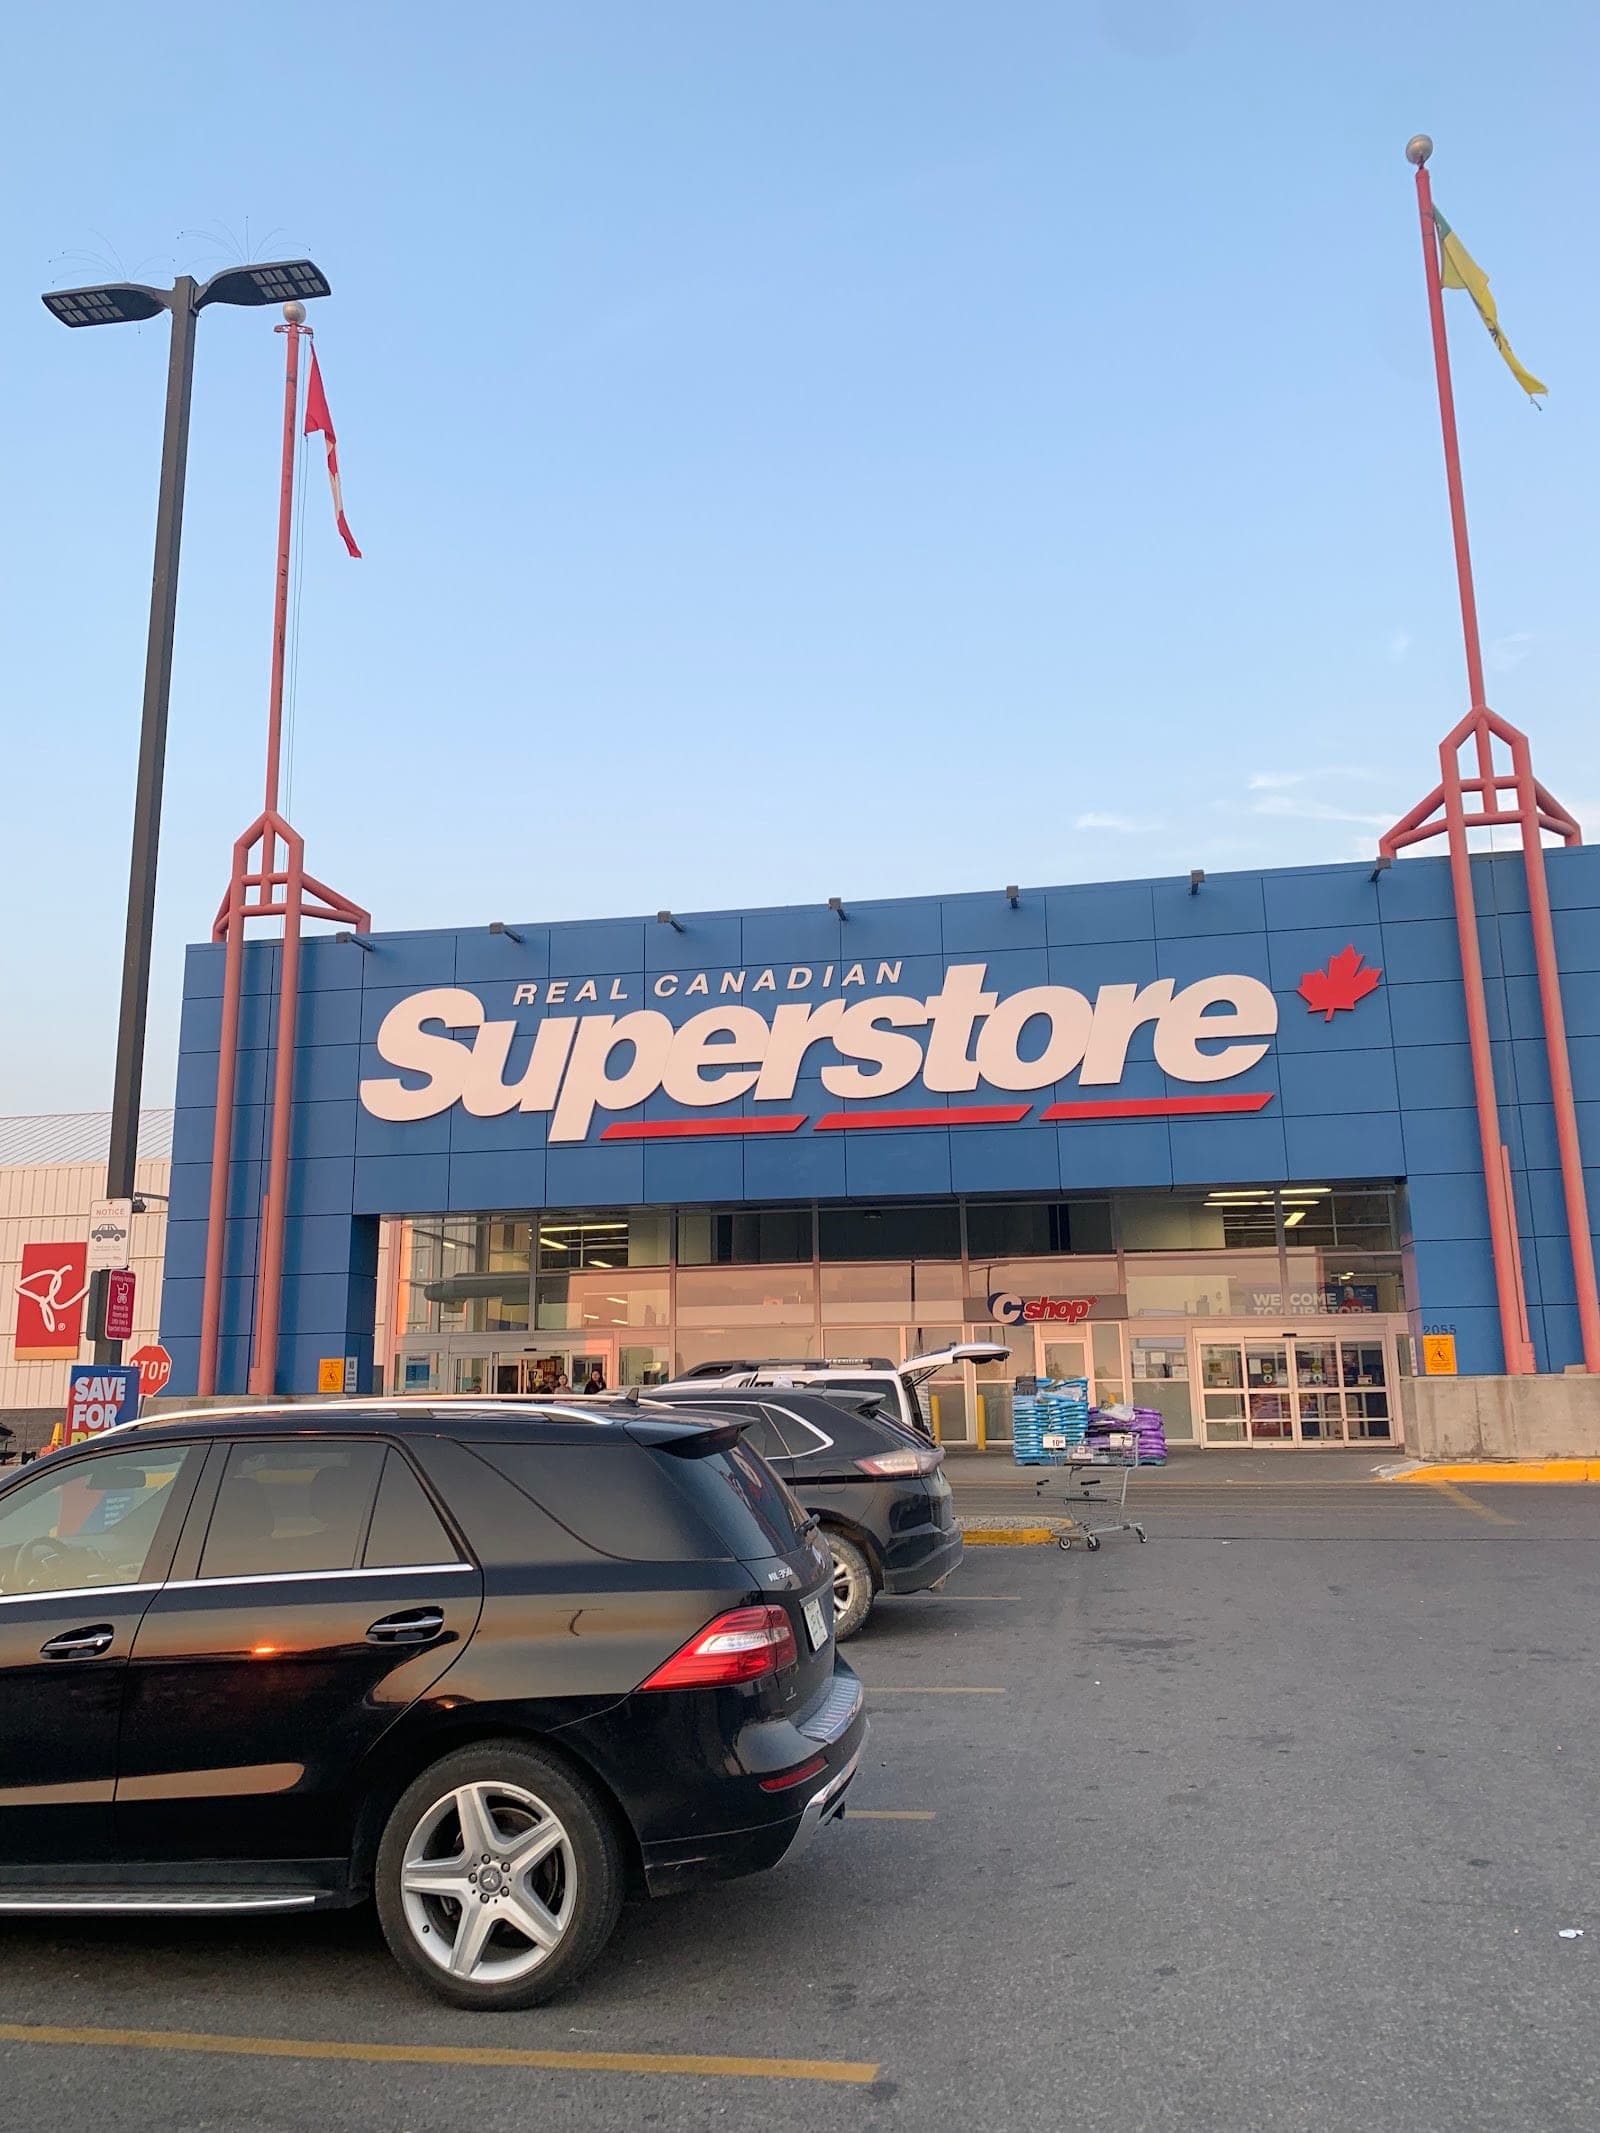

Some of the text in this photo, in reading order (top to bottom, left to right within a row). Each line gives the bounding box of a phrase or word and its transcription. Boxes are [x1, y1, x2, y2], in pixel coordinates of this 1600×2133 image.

[512, 961, 903, 1006] REAL CANADIAN
[359, 962, 1279, 1143] Superstore
[96, 1208, 125, 1216] NOTICE
[1253, 1292, 1338, 1306] WECOME
[1423, 1324, 1456, 1335] 2055
[74, 1376, 126, 1402] SAVE
[72, 1403, 118, 1429] FOR
